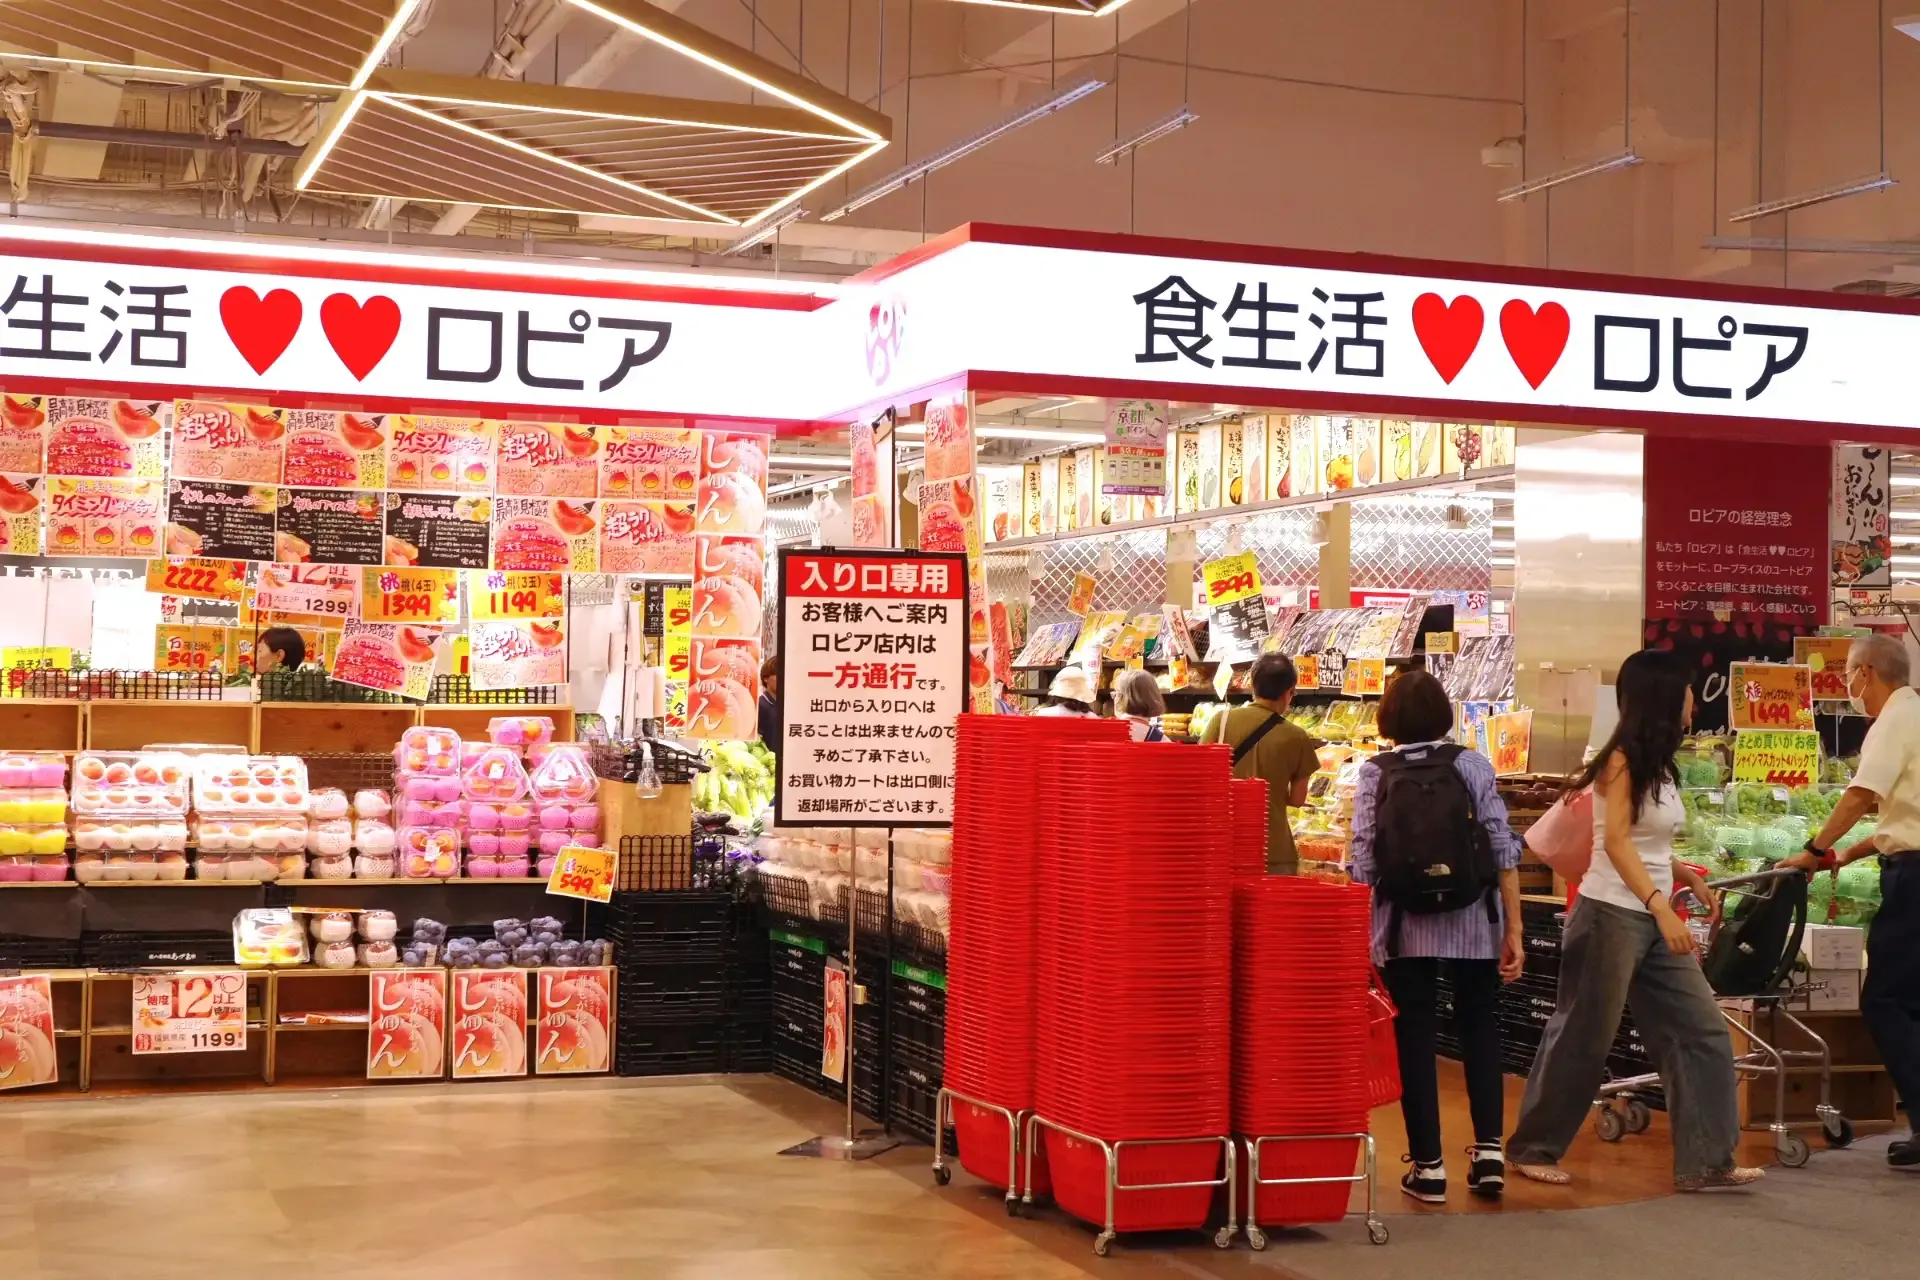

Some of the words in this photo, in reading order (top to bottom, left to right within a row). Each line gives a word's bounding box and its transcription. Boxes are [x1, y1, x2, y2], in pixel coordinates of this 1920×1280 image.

[0, 275, 192, 368] 生活
[427, 306, 672, 392] ロピア
[1132, 275, 1387, 378] 食生活
[1595, 314, 1808, 400] ロピア
[1689, 508, 1793, 527] ロピアの経営理念
[164, 565, 219, 593] 2222
[692, 535, 729, 629] しゅん
[800, 560, 949, 595] 入り口専用
[1209, 571, 1254, 598] 399
[1656, 580, 1813, 596] をつくることを目標に生まれた会社です。
[305, 598, 347, 614] 1299
[383, 594, 431, 616] 1399
[491, 591, 537, 614] 1199
[801, 601, 947, 624] お客様へご案内
[812, 633, 936, 654] ロピア店内は
[168, 651, 205, 668] 399
[687, 640, 723, 732] しゅん
[808, 661, 946, 691] 一方通行です。
[810, 699, 935, 714] 出口から入り口へは
[788, 723, 955, 739] 戻ることは出来ませんので
[1737, 734, 1816, 749] まとめ買いがお得
[812, 748, 931, 764] 予めご了承下さい。
[788, 774, 954, 789] お買い物カートは出口側に
[798, 799, 945, 814] 返却場所がございます。
[576, 865, 601, 877] プルーン
[559, 873, 594, 894] 599
[167, 977, 213, 1018] 12
[213, 993, 235, 1004] 以上
[371, 976, 407, 1069] しゅん
[456, 976, 492, 1068] しゅん
[539, 974, 573, 1064] しゅん
[192, 1032, 235, 1047] 1199
